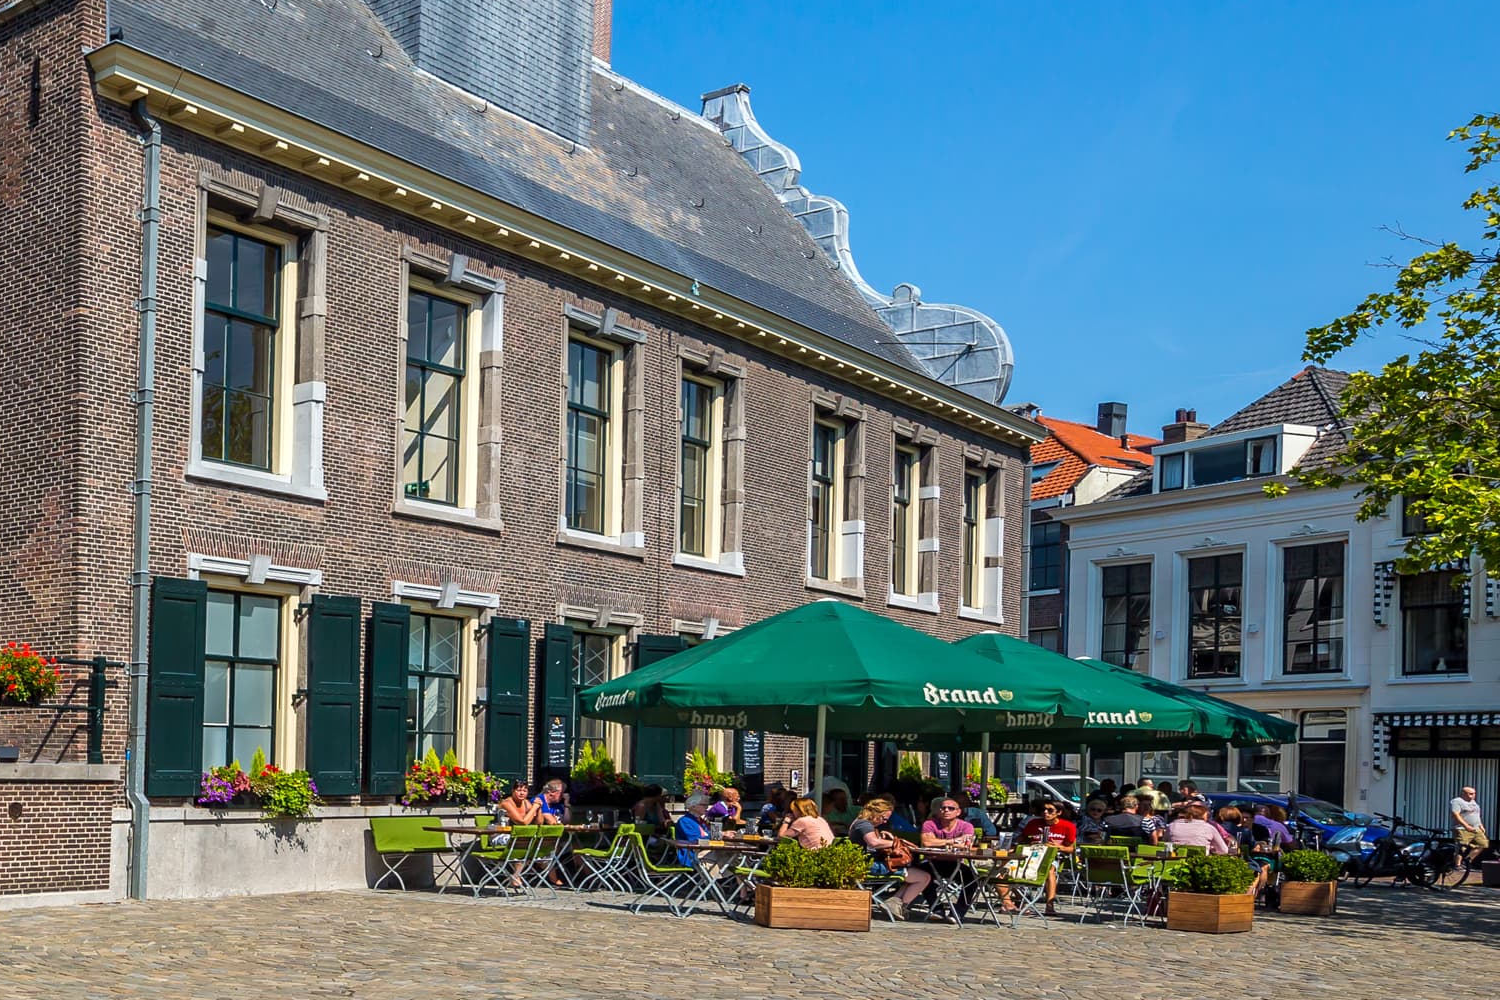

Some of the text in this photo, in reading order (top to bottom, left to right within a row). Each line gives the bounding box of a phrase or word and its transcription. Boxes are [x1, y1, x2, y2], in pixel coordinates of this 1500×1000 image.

[594, 689, 629, 711] Brand
[923, 682, 999, 705] Brand
[1084, 709, 1139, 725] rand
